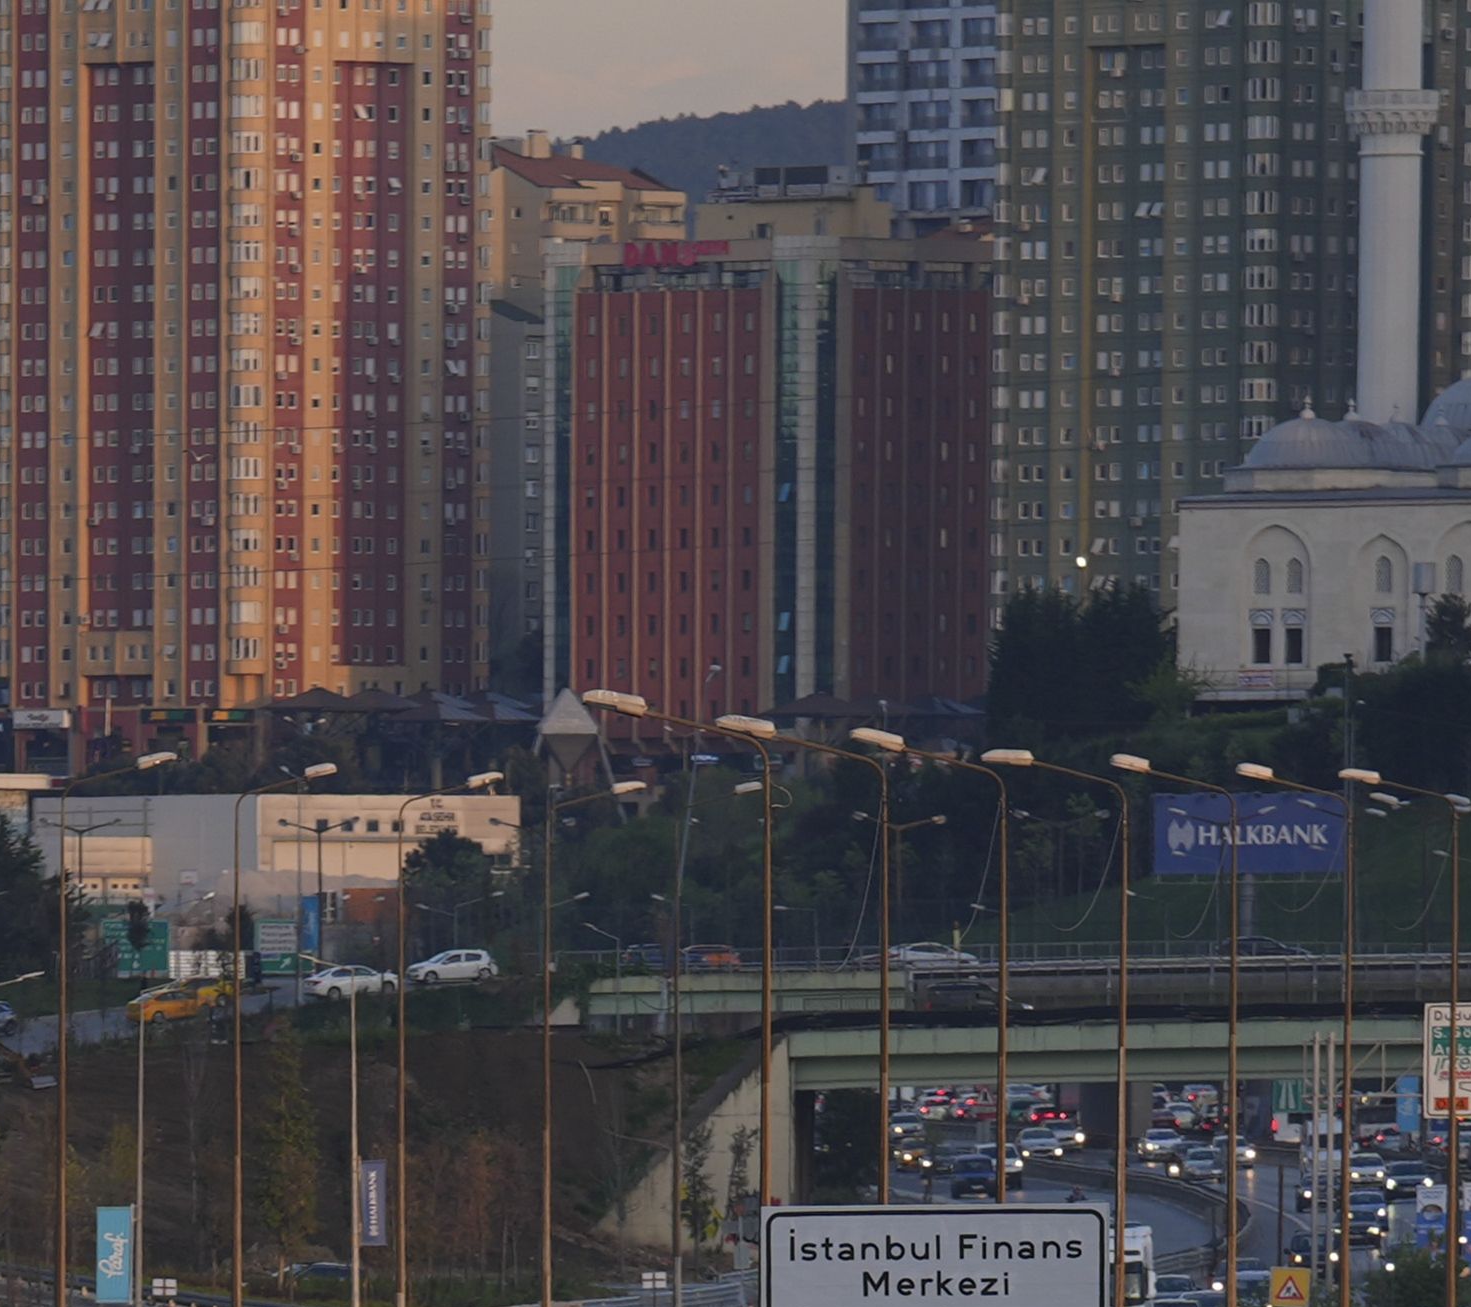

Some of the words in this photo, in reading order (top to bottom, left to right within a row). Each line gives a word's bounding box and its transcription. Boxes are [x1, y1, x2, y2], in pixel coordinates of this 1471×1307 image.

[1198, 823, 1329, 846] HALKBANK
[790, 1229, 941, 1261] İstanbul
[959, 1233, 1083, 1260] Finans
[863, 1270, 1010, 1297] Merkezi
